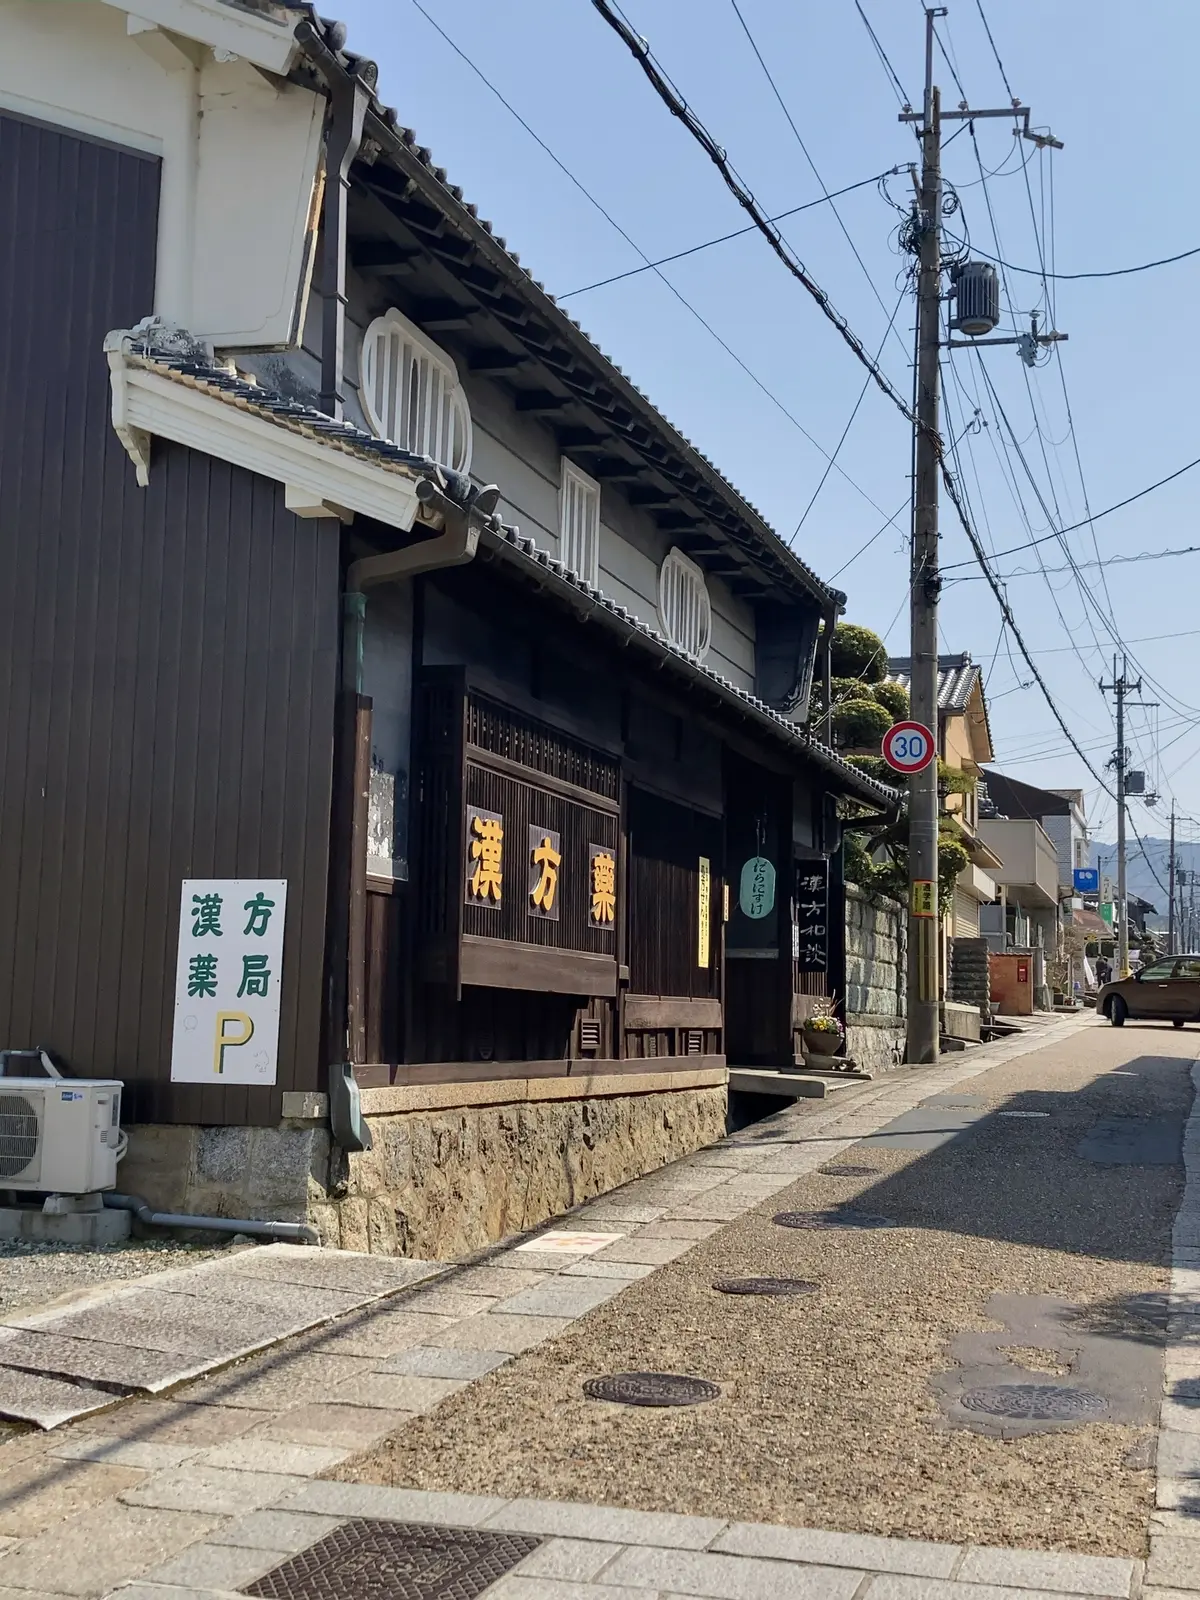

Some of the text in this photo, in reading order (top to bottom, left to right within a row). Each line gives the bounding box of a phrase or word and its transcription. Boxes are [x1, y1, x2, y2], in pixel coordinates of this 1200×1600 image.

[894, 735, 924, 758] 30
[750, 861, 768, 915] だらにすけ
[191, 892, 276, 937] 漢方
[187, 953, 272, 999] 薬局
[213, 1010, 255, 1074] P
